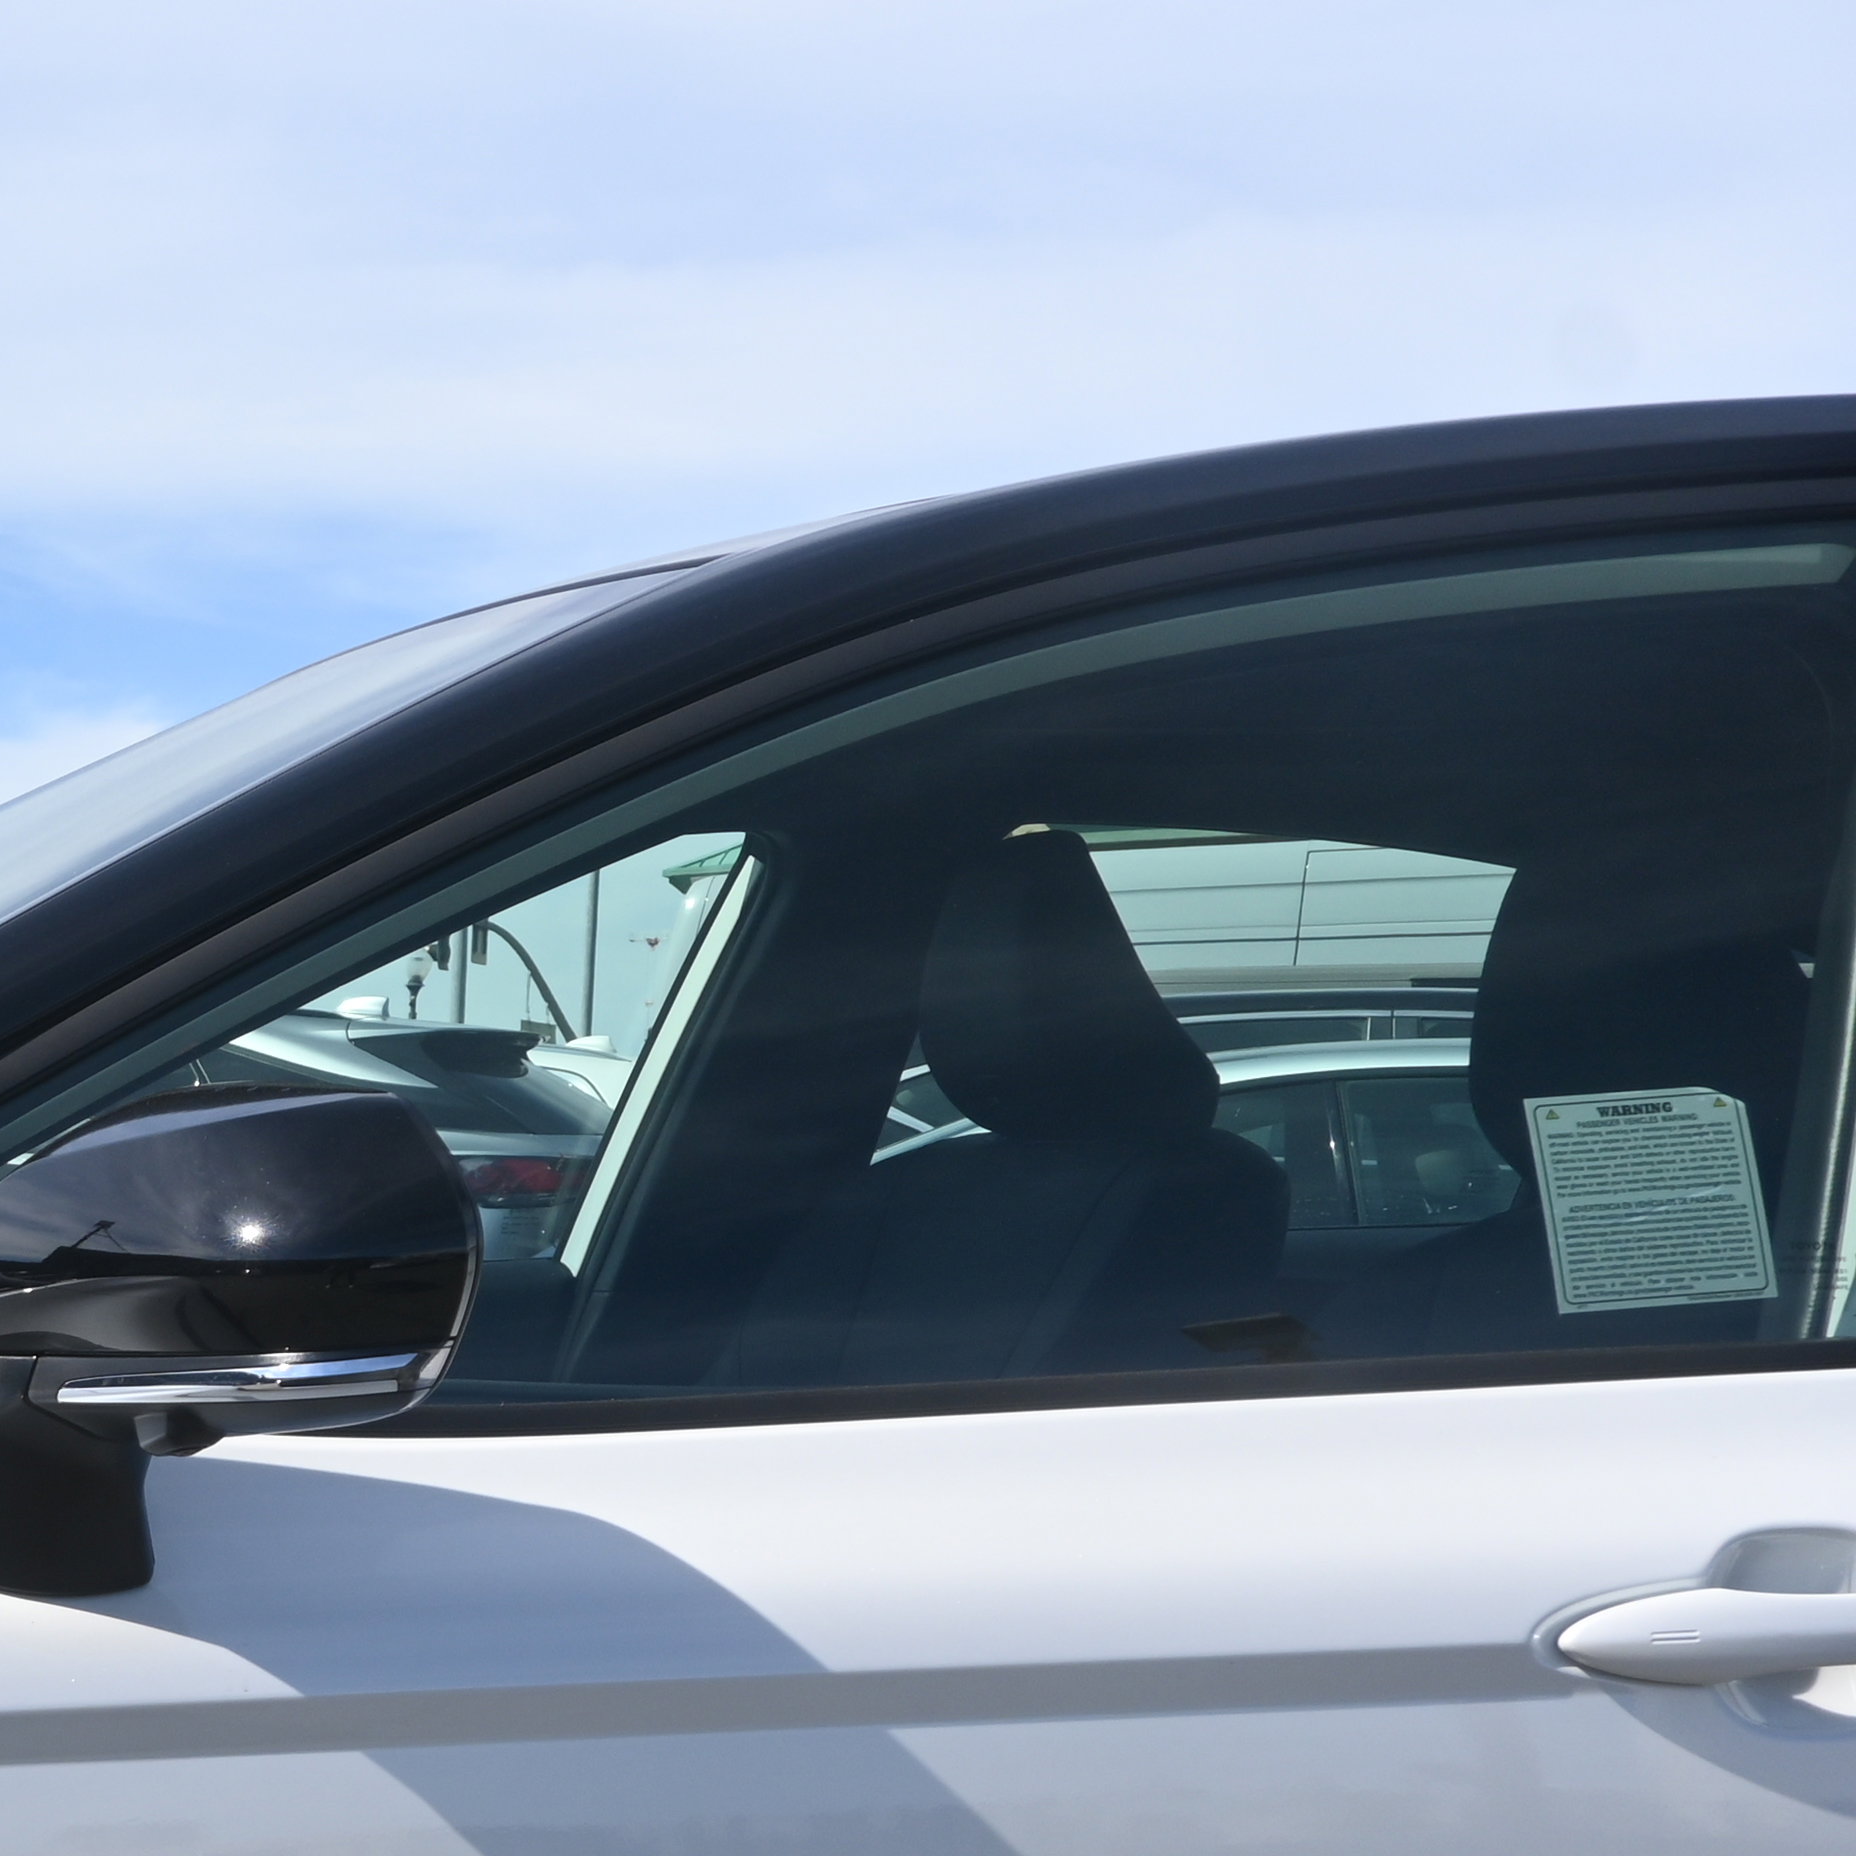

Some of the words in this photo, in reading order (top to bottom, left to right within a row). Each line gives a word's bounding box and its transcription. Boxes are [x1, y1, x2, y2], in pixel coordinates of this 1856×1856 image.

[1596, 1101, 1674, 1118] WARNING
[1576, 1118, 1620, 1129] PASSENGER
[1623, 1115, 1659, 1126] VEHICLES
